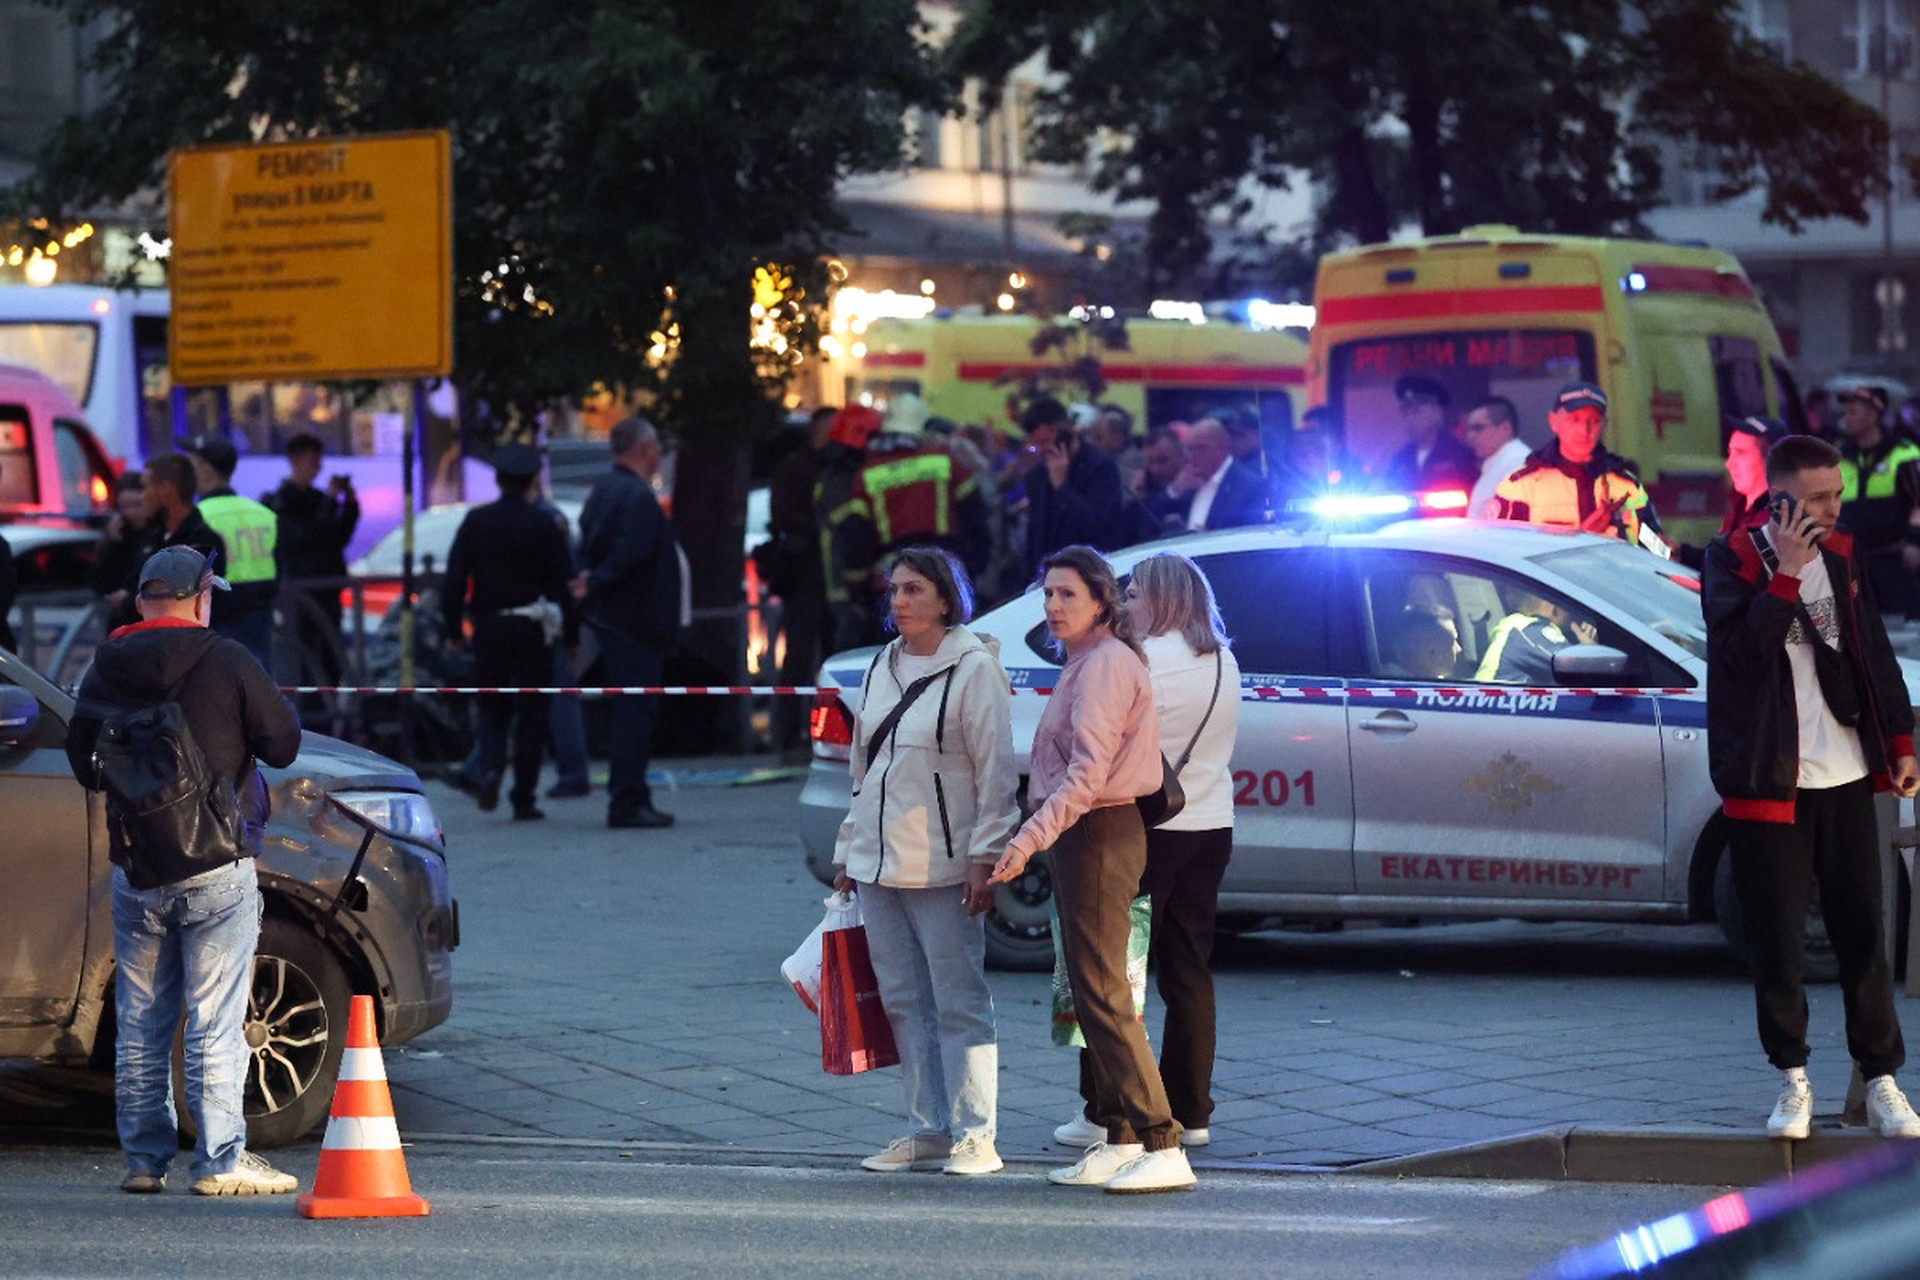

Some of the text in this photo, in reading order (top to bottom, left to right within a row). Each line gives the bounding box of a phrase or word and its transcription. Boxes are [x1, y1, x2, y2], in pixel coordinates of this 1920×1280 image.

[257, 150, 347, 177] РЕМОНТ
[1232, 769, 1315, 807] 201
[1381, 855, 1641, 889] ЕКАТЕРИНБУРГ
